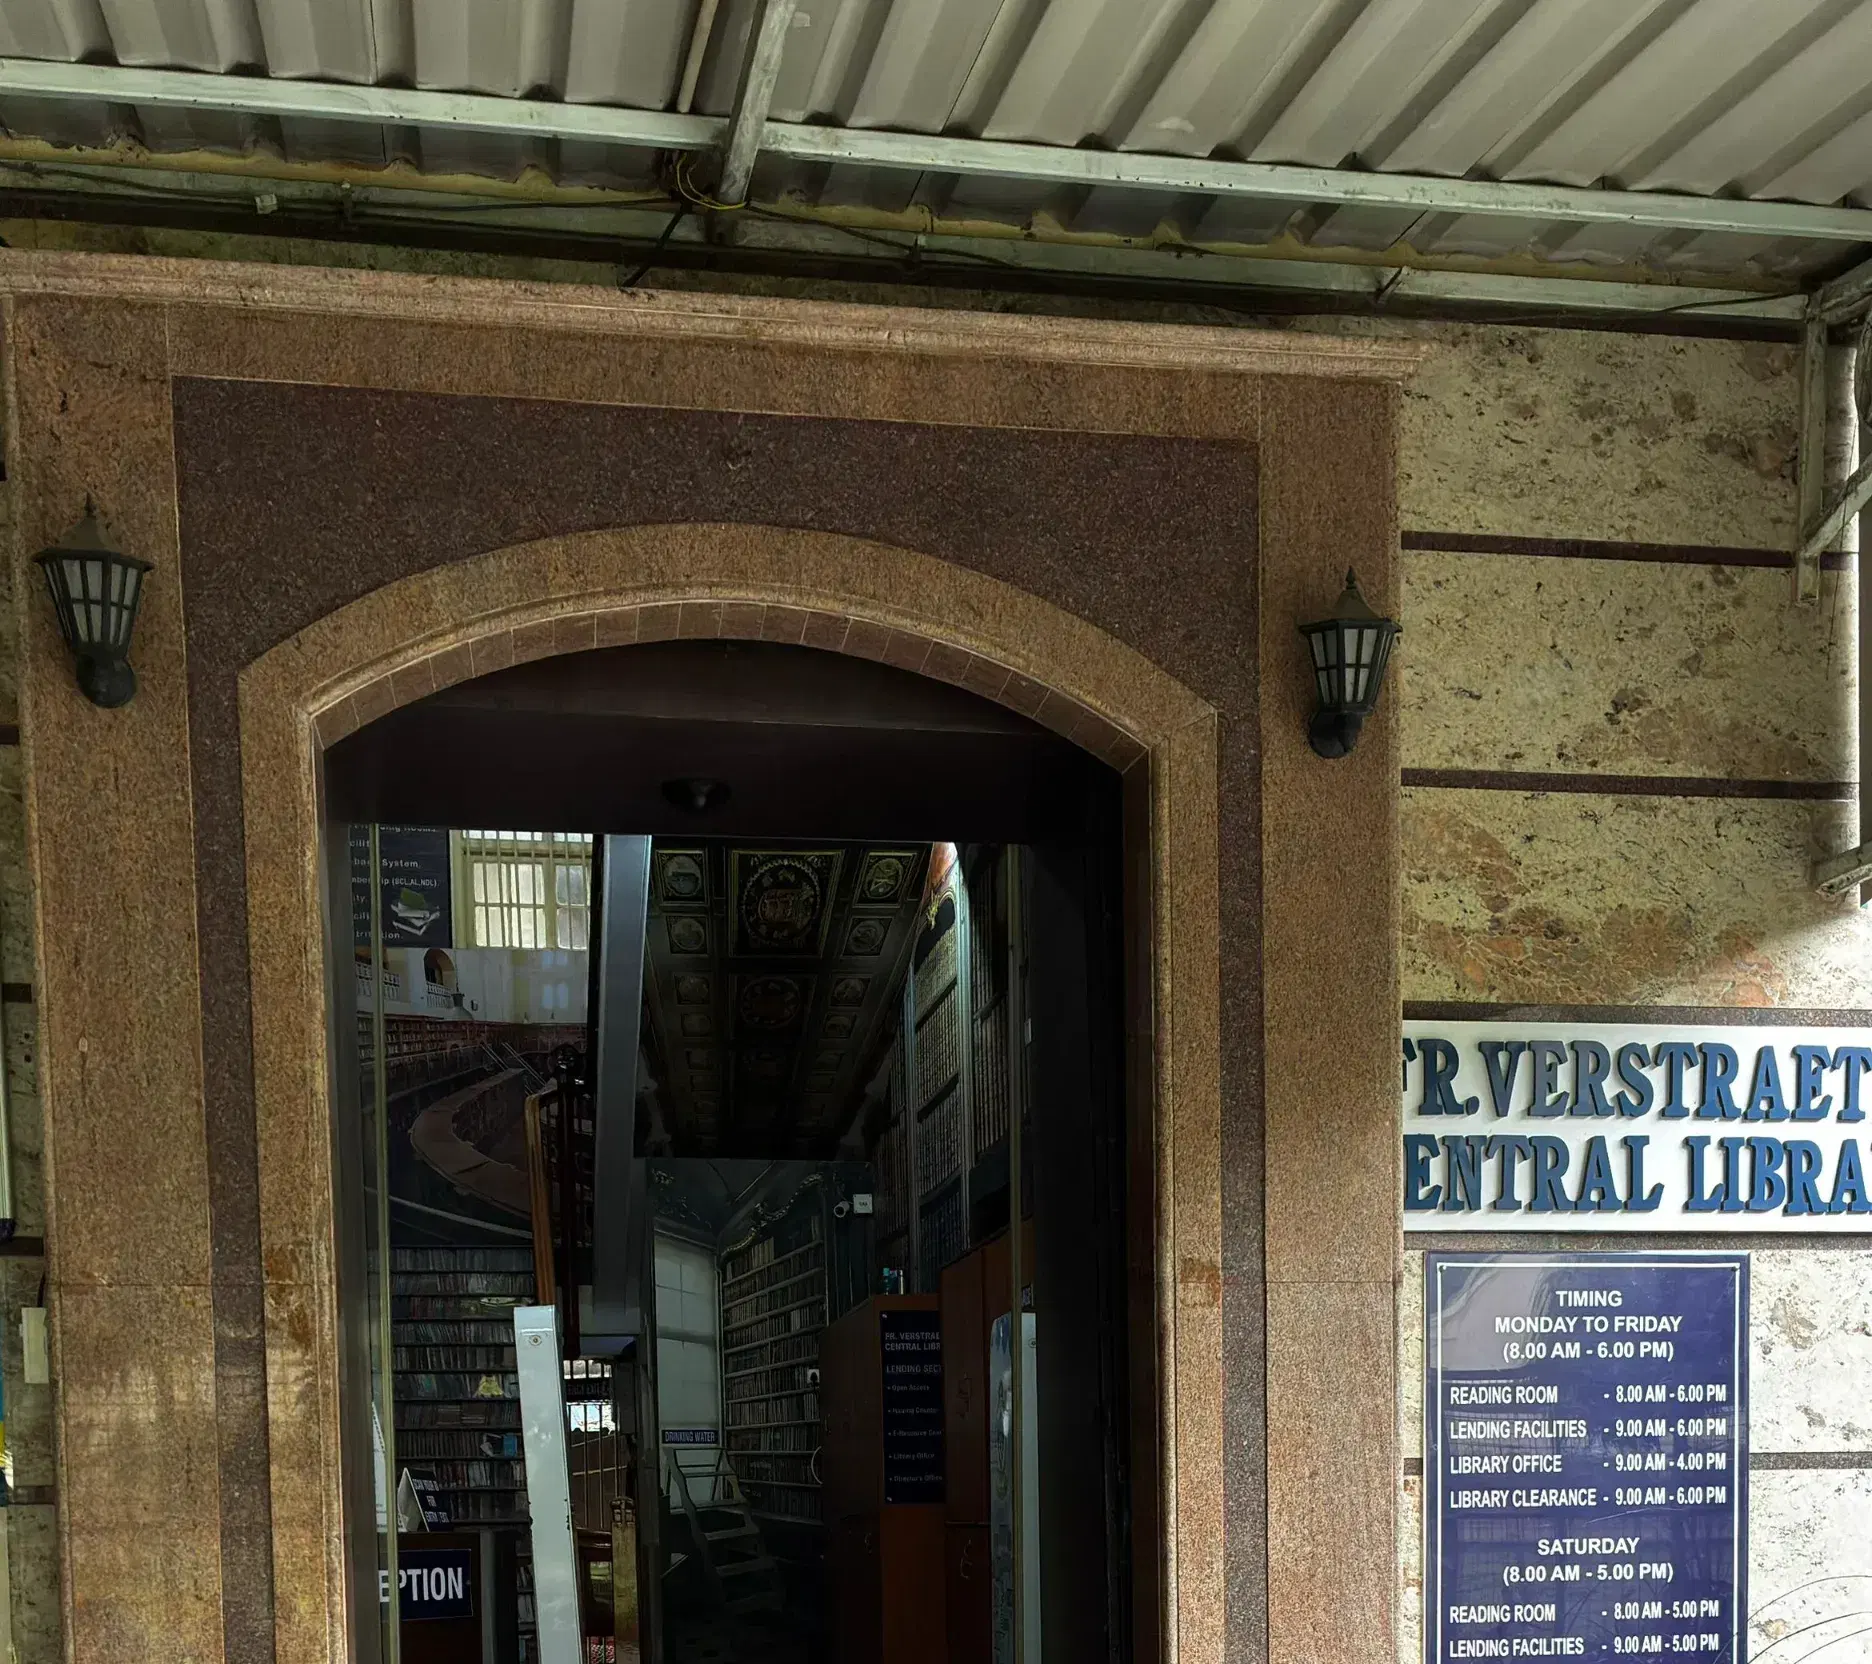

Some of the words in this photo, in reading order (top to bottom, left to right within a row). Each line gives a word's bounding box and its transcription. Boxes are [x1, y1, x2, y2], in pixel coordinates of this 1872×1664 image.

[1685, 1136, 1872, 1215] LIBRA
[1555, 1290, 1623, 1308] TIMING
[1494, 1316, 1579, 1334] MONDAY
[1582, 1315, 1609, 1333] TO
[1614, 1315, 1683, 1333] FRIDAY
[1502, 1341, 1547, 1363] (8.00
[1550, 1341, 1581, 1359] AM
[1597, 1341, 1635, 1359] 6.00
[1639, 1340, 1674, 1362] PM)
[1450, 1386, 1512, 1405] READING
[1515, 1385, 1558, 1404] ROOM
[1615, 1384, 1643, 1403] 8.00
[1644, 1384, 1667, 1403] AM
[1677, 1384, 1704, 1403] 6.00
[1706, 1384, 1727, 1403] PM
[664, 1431, 694, 1443] DRINKING
[694, 1431, 715, 1443] WATER
[1450, 1420, 1511, 1440] LENDING
[1513, 1419, 1587, 1439] FACILITIES
[1615, 1419, 1643, 1437] 9.00
[1644, 1418, 1666, 1437] AM
[1677, 1418, 1704, 1437] 6.00
[1706, 1418, 1727, 1436] PM
[1450, 1455, 1510, 1474] LIBRARY
[1512, 1454, 1563, 1474] OFFICE
[1615, 1453, 1643, 1472] 9.00
[1644, 1453, 1666, 1471] AM
[1676, 1452, 1703, 1471] 4.00
[1706, 1452, 1727, 1470] PM
[1450, 1489, 1510, 1509] LIBRARY
[1512, 1488, 1597, 1508] CLEARANCE
[1615, 1487, 1642, 1506] 9.00
[1644, 1486, 1666, 1505] AM
[1676, 1486, 1703, 1505] 6.00
[1706, 1486, 1726, 1504] PM
[1537, 1537, 1640, 1556] SATURDAY
[1503, 1565, 1547, 1587] (8.00
[1550, 1564, 1580, 1582] AM
[1597, 1563, 1634, 1581] 5.00
[1639, 1562, 1674, 1583] PM)
[1449, 1604, 1511, 1624] READING
[1514, 1603, 1556, 1623] ROOM
[1613, 1601, 1640, 1620] 8.00
[1641, 1601, 1662, 1619] AM
[1672, 1600, 1698, 1619] 5.00
[1700, 1599, 1719, 1618] PM
[1449, 1638, 1509, 1658] LENDING
[1512, 1636, 1585, 1657] FACILITIES
[1613, 1635, 1640, 1654] 9.00
[1641, 1635, 1662, 1653] AM
[1672, 1634, 1697, 1652] 5.00
[1700, 1633, 1719, 1651] PM
